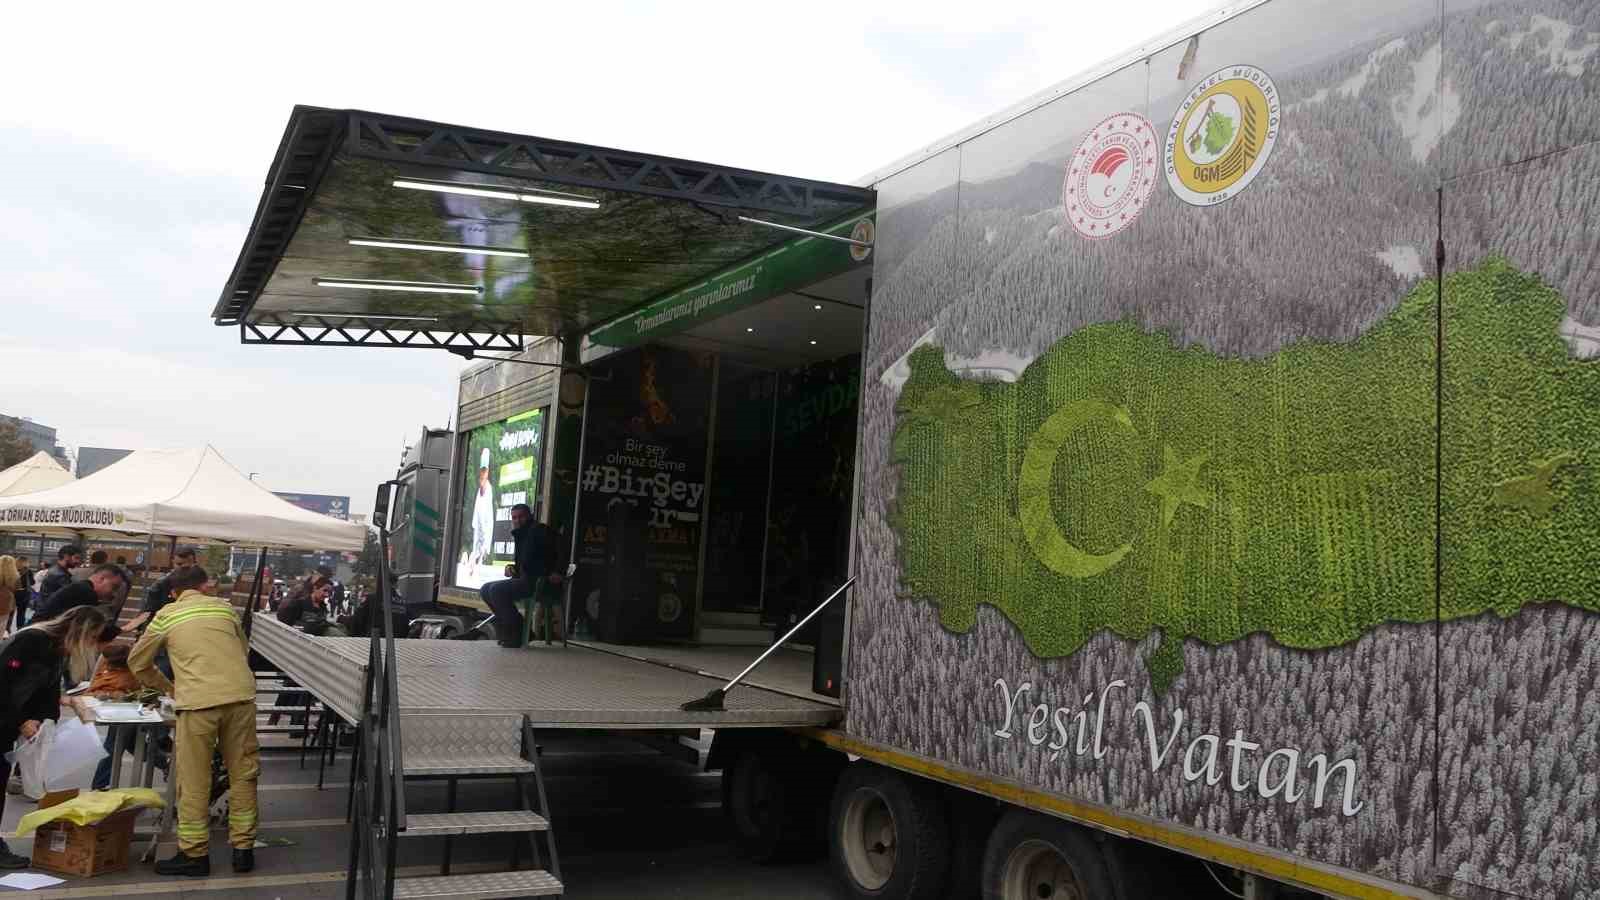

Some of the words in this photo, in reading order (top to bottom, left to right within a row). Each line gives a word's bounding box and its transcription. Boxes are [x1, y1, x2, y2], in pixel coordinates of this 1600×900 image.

[1166, 120, 1180, 175] ORMAN
[1183, 74, 1224, 111] GENEL
[1232, 68, 1279, 139] MÜDÜRLÜĞÜ
[1193, 164, 1220, 182] OGM
[625, 437, 644, 452] Bir
[645, 443, 667, 459] şey
[606, 450, 647, 466] olmaz
[649, 454, 687, 472] deme
[582, 464, 704, 508] #BirŞey
[8, 508, 34, 522] ORMAN
[62, 505, 113, 525] MÜDÜRLÜĞÜ
[994, 678, 1127, 762] Yeşil
[1132, 701, 1363, 816] Vatan
